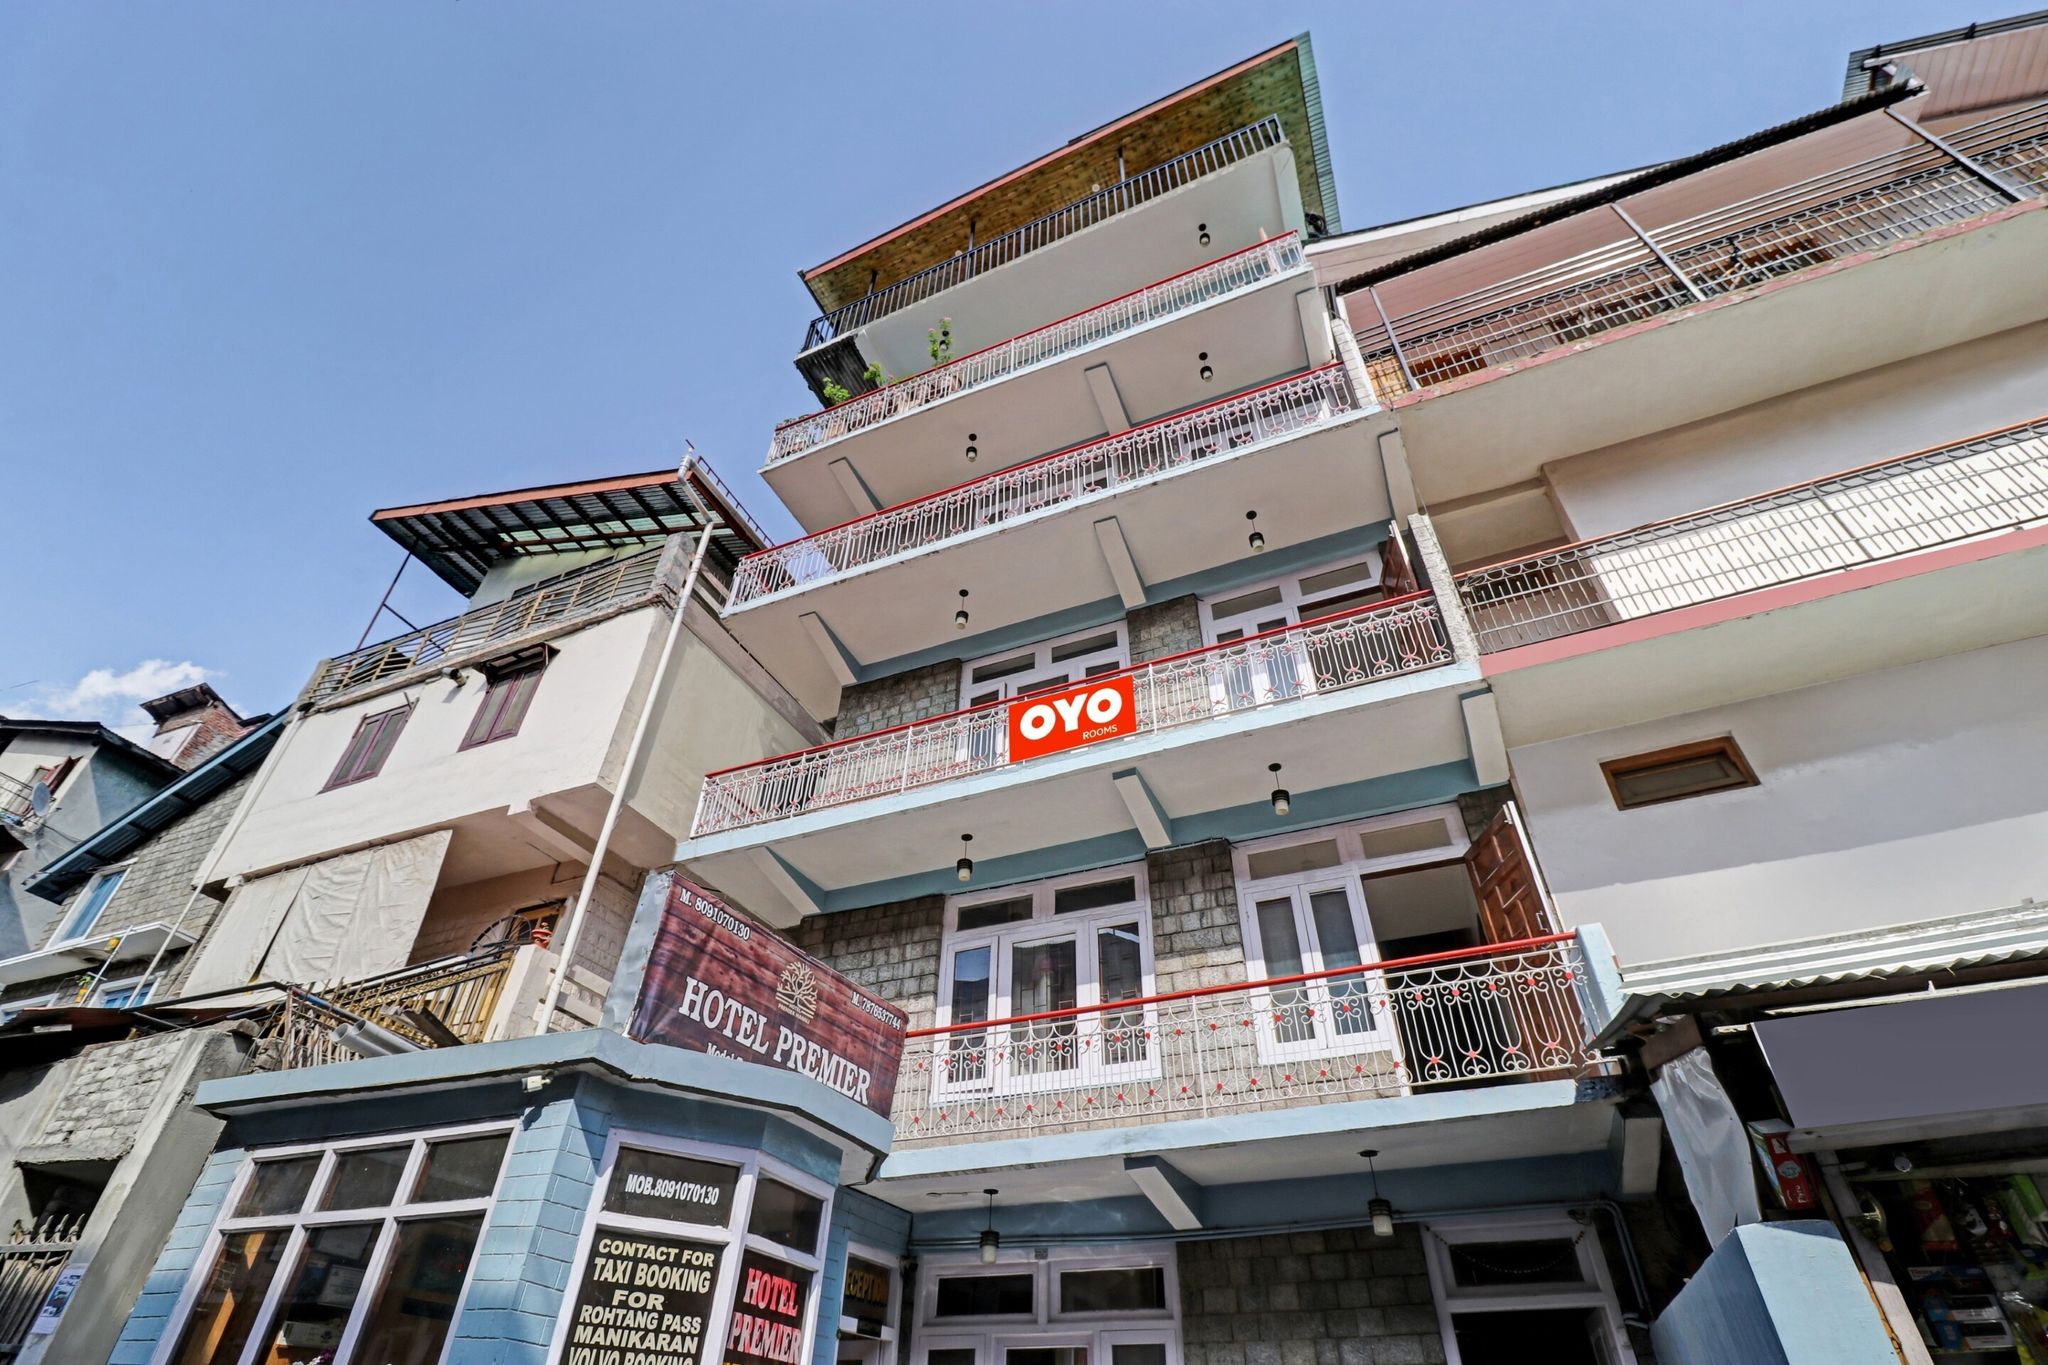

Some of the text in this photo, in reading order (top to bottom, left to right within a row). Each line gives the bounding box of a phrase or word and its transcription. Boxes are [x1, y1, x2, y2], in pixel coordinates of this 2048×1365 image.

[1020, 688, 1122, 740] OYO
[1083, 725, 1118, 740] ROOMS
[680, 888, 750, 940] M. 8091070130
[678, 976, 871, 1104] HOTEL PREMIER
[625, 1173, 720, 1206] MOB.8091070130
[599, 1239, 715, 1268] CONTACT FOR
[593, 1257, 711, 1294] TAXI BOOKING
[743, 1267, 800, 1318] HOTEL
[611, 1289, 665, 1311] FOR
[579, 1304, 701, 1335] ROHTANG PASS
[573, 1324, 699, 1354] MANIKARAN
[727, 1311, 802, 1365] PREMIER
